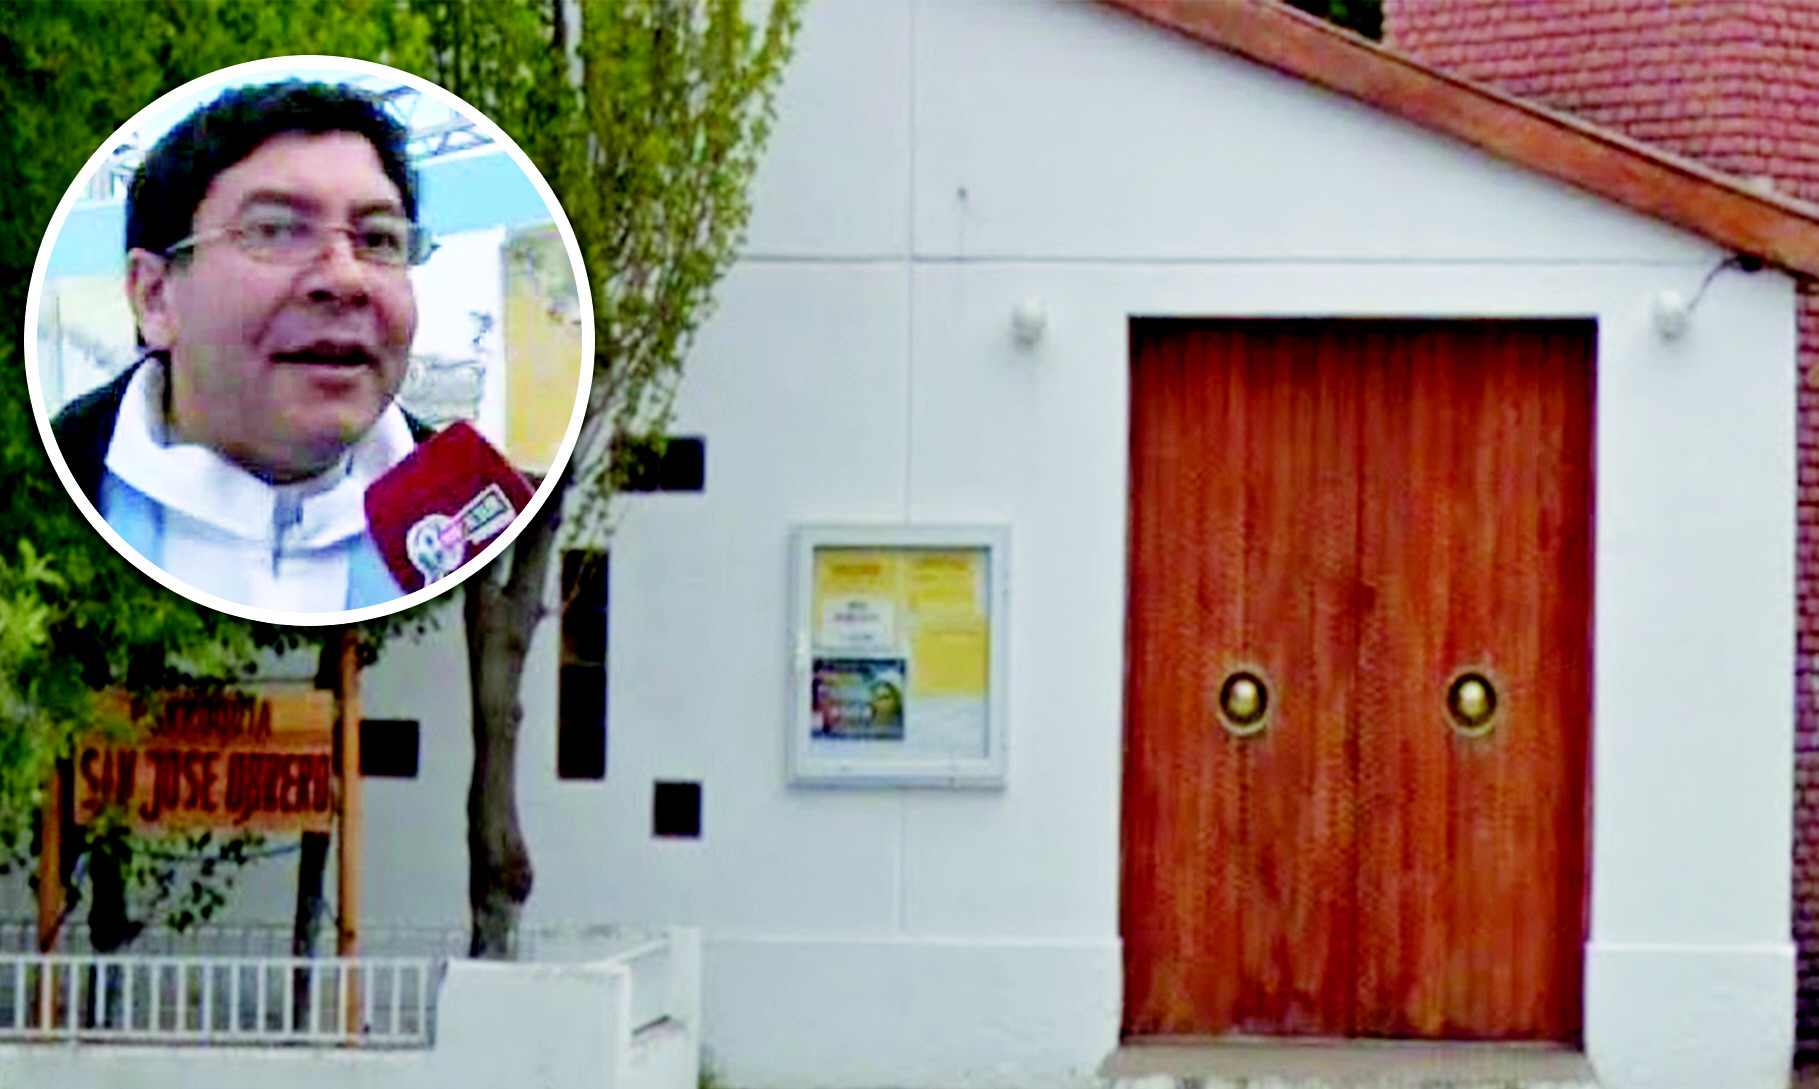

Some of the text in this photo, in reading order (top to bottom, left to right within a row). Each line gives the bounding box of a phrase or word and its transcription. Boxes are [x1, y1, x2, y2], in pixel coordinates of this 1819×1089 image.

[80, 747, 330, 826] SAN JOSE OBRERO
